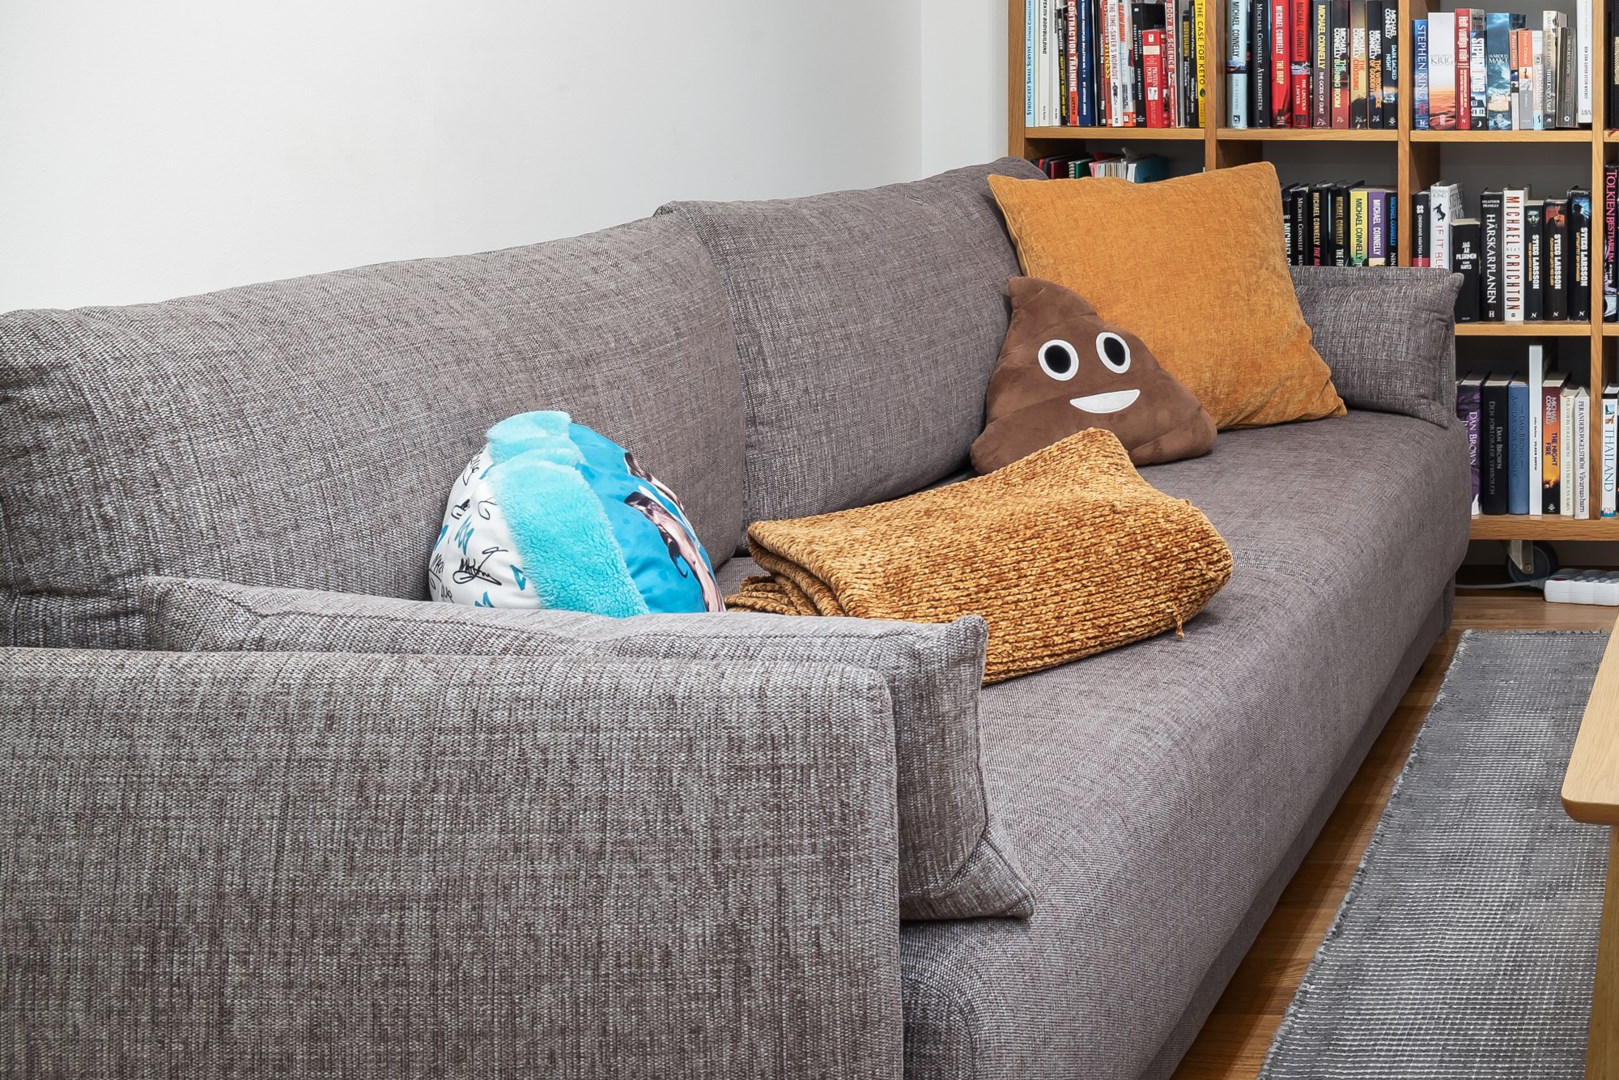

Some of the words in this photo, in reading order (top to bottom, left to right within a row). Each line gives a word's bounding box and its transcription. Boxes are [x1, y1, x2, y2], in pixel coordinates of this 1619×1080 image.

[1068, 1, 1076, 52] CONTRACTION
[1167, 26, 1173, 35] BY
[1418, 25, 1426, 69] STEPHEN
[1431, 56, 1454, 65] KRIG
[1418, 73, 1426, 99] KING
[1507, 196, 1519, 245] MICHAEL
[1373, 227, 1381, 254] CONNELLY
[1487, 214, 1497, 303] HÄRSKARPLANEN
[1507, 254, 1519, 310] CRICHTON
[1469, 412, 1477, 431] DAN
[1469, 434, 1477, 465] BROWN
[1605, 430, 1614, 491] THAILAND
